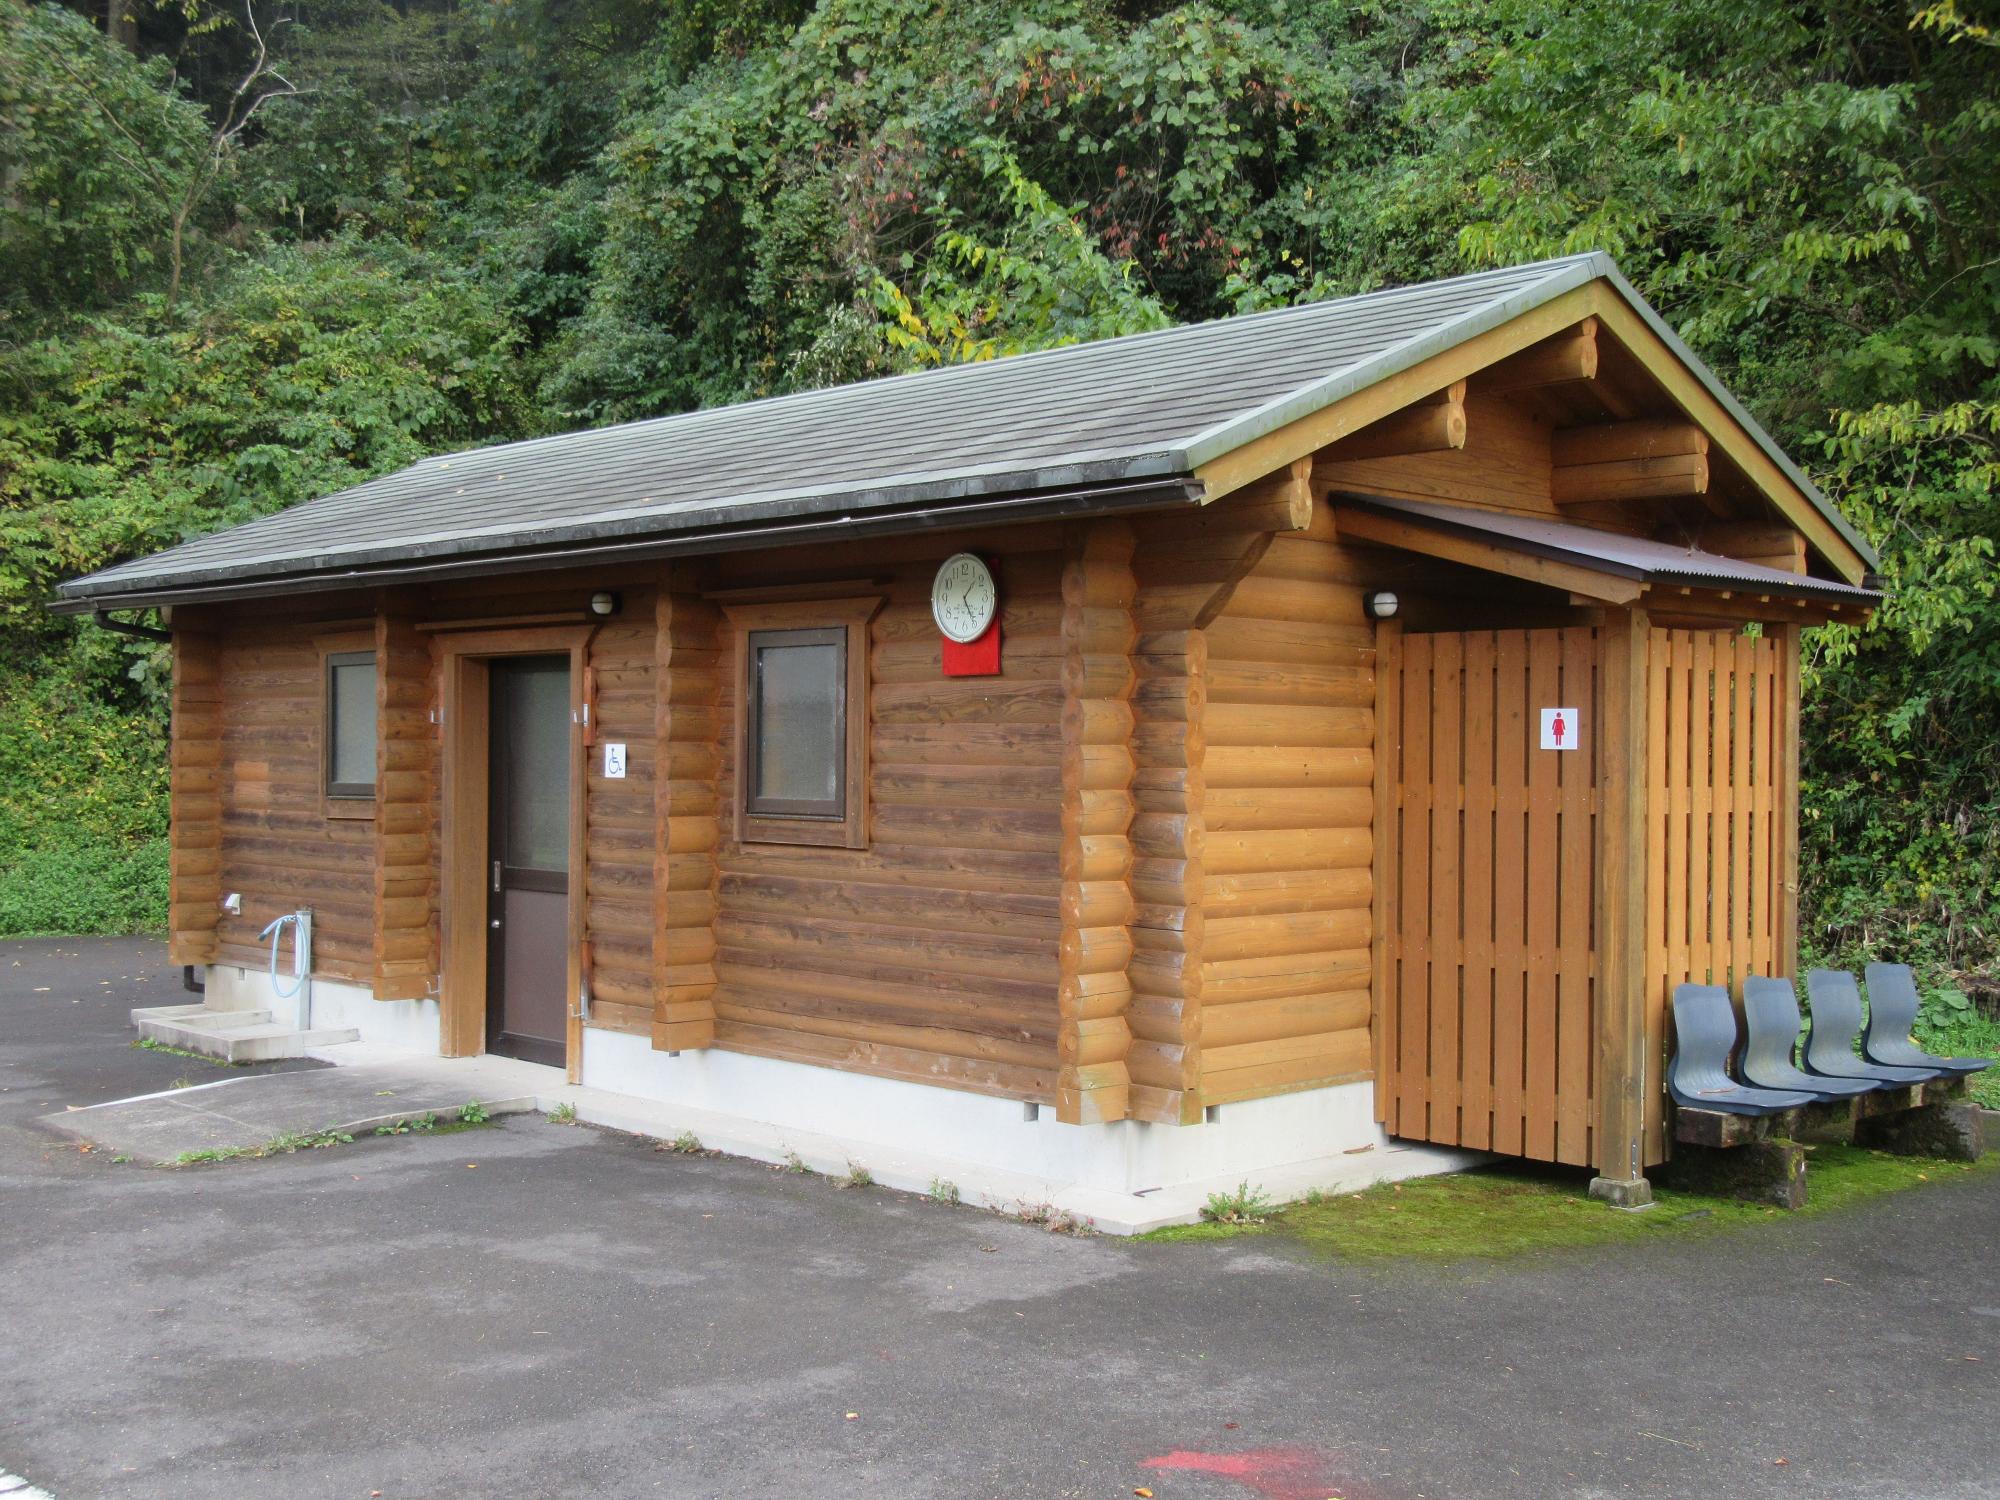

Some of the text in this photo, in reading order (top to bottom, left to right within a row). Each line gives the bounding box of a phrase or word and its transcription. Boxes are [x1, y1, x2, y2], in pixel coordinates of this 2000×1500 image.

[952, 567, 959, 580] 11
[961, 563, 969, 576] 12
[945, 576, 953, 591] 10
[978, 574, 985, 587] 2
[942, 592, 948, 606] 9
[982, 589, 989, 602] 3
[945, 606, 952, 620] 8
[978, 605, 985, 619] 4
[953, 617, 959, 630] 7
[961, 620, 968, 632] 6
[970, 616, 978, 629] 5
